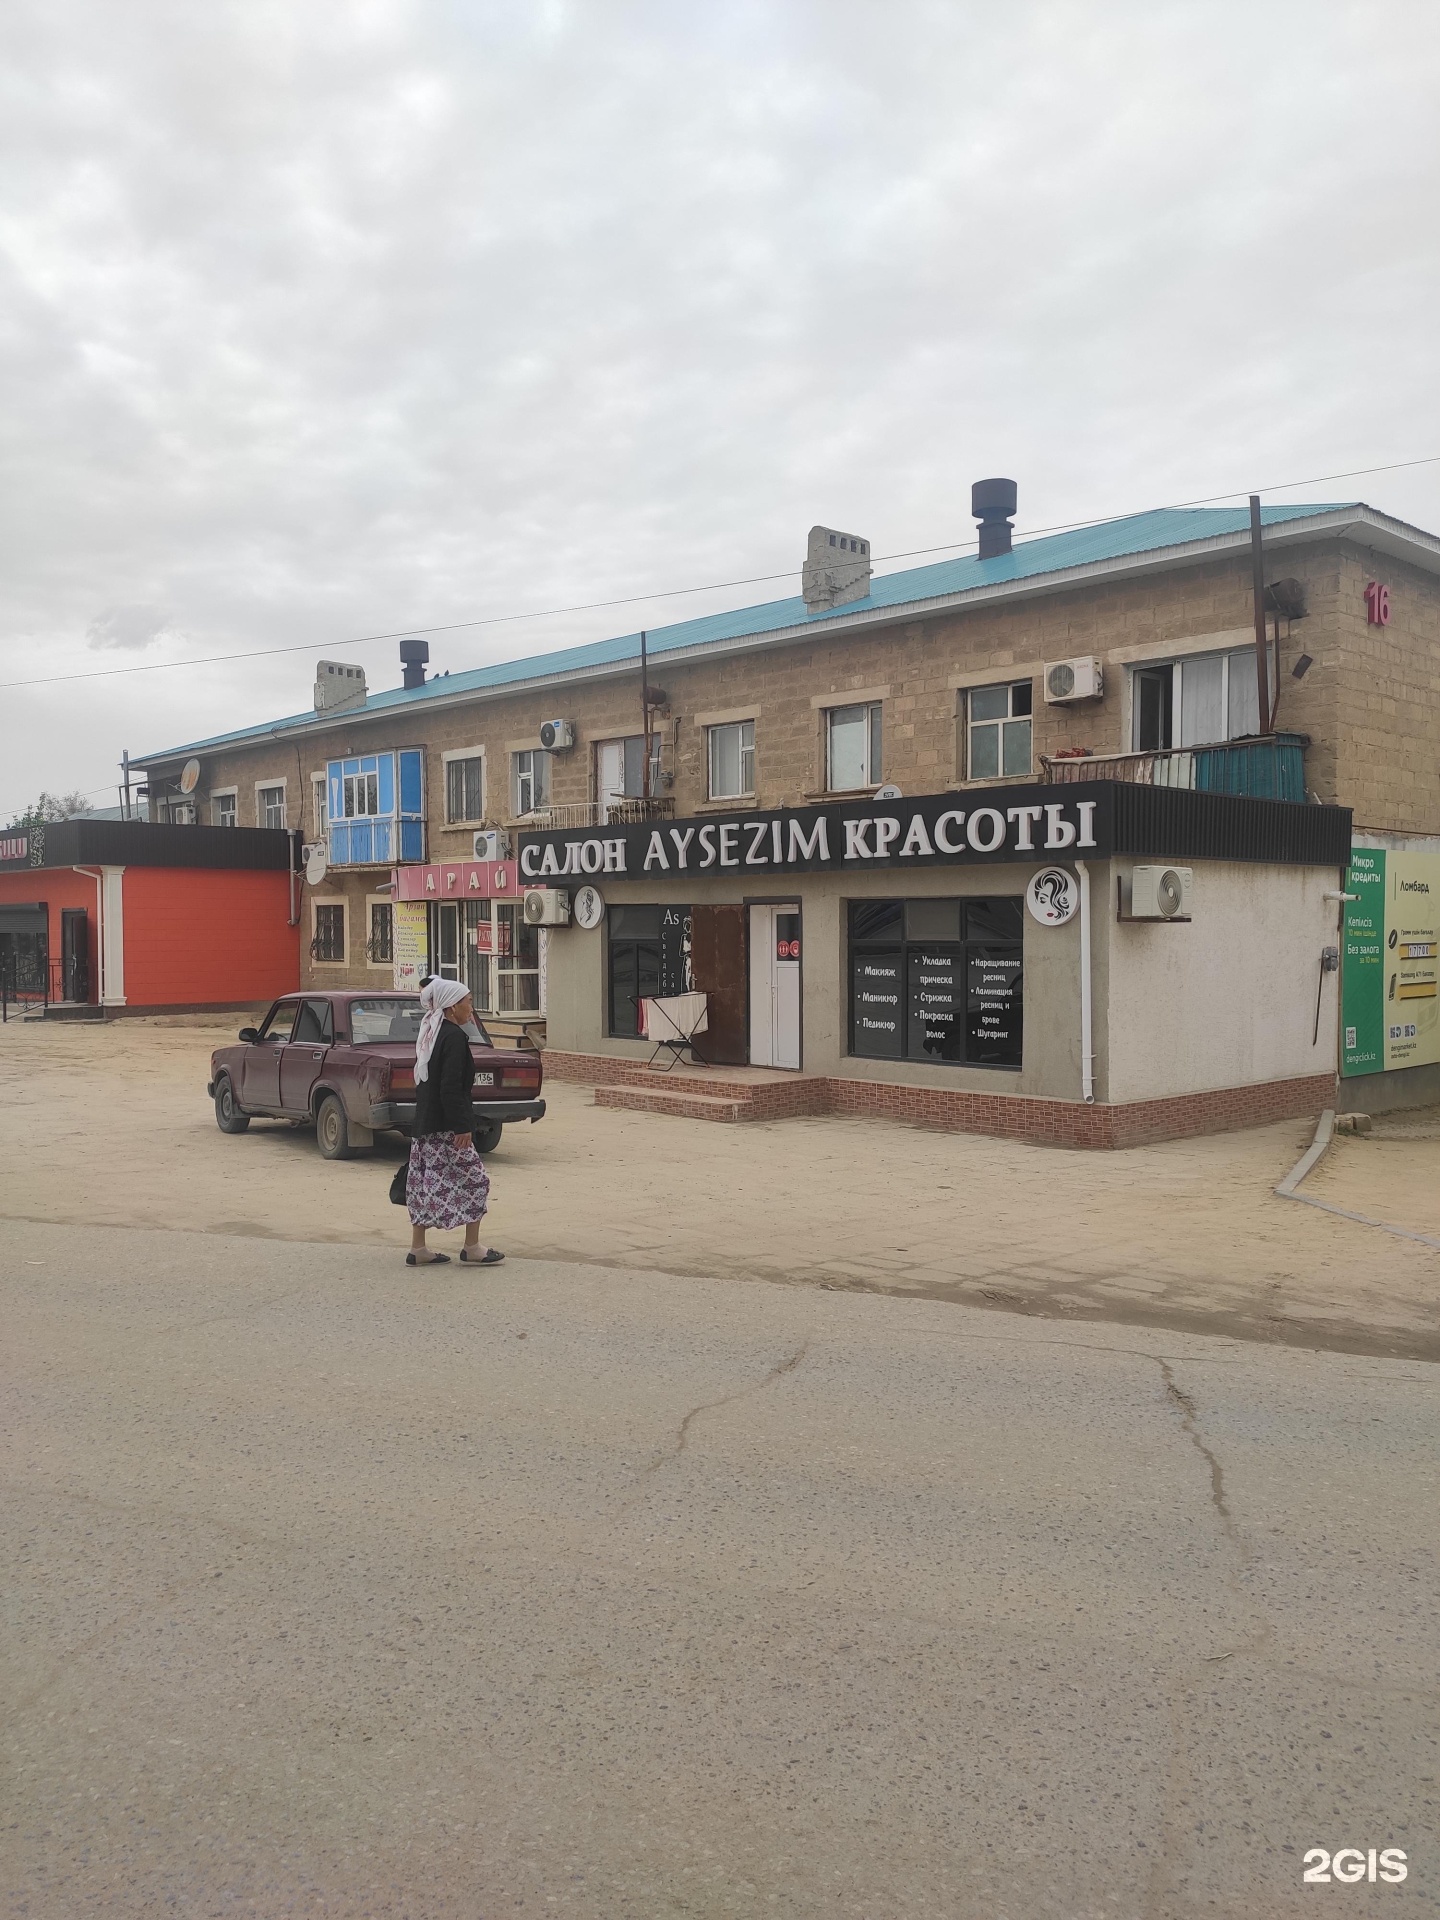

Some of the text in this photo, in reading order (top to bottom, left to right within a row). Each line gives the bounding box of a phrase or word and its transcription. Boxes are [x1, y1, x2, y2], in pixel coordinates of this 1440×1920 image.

[1364, 582, 1391, 626] 16
[520, 801, 1097, 877] САЛОН AYSEZIM КРАСОТЫ
[1352, 854, 1374, 870] Микро
[426, 865, 507, 892] АРАЙ
[1351, 871, 1380, 883] кредиты
[1400, 880, 1429, 894] Ломбард
[1347, 943, 1379, 954] Без залога
[922, 955, 951, 966] Укладка
[975, 959, 1021, 969] Наращивание
[864, 965, 896, 977] Макияж
[920, 975, 953, 986] прическа
[983, 973, 1006, 983] ресниц
[920, 991, 952, 1004] Стрижка
[975, 987, 1013, 996] Ламинация
[862, 991, 898, 1005] Маникюр
[980, 1001, 1003, 1010] ресниц
[919, 1009, 954, 1022] Покраска
[982, 1015, 1000, 1025] брове
[862, 1017, 896, 1032] Педикюр
[926, 1029, 946, 1039] волос
[977, 1028, 1009, 1040] Шугаринг
